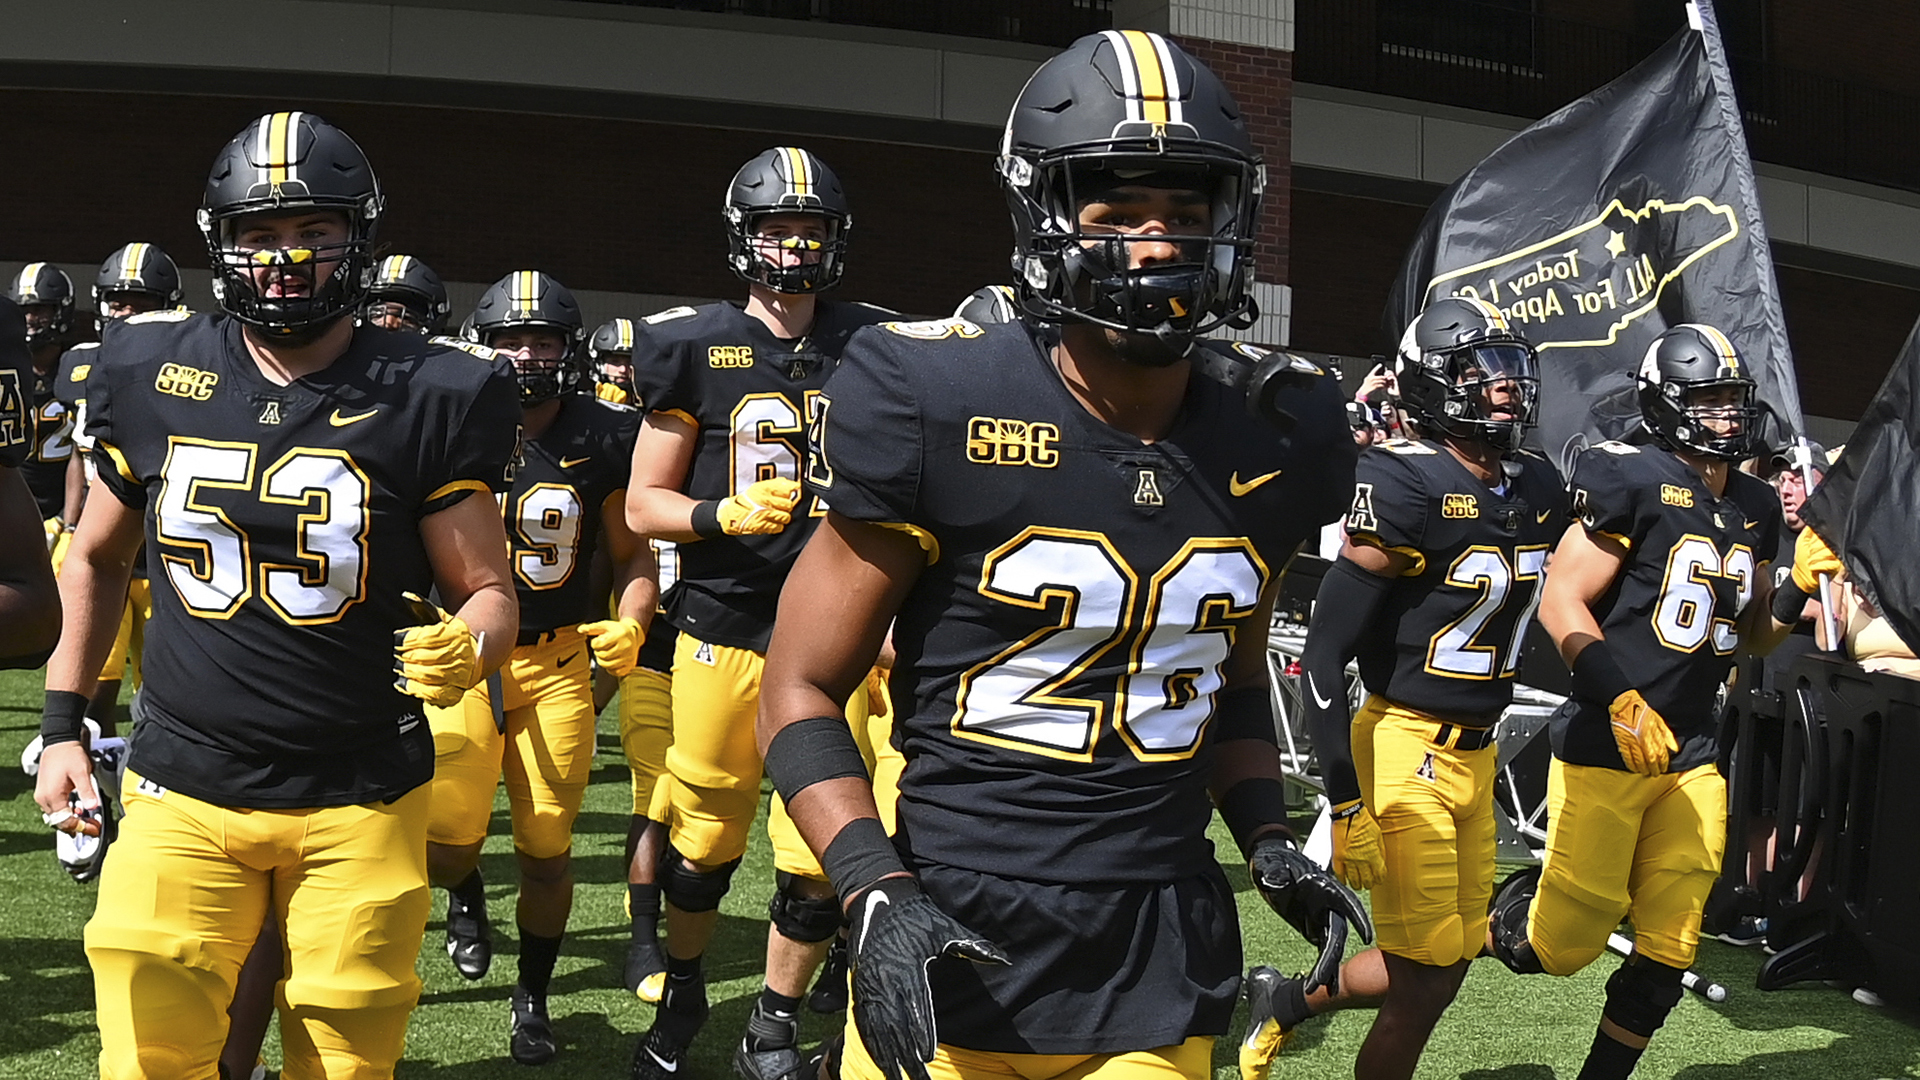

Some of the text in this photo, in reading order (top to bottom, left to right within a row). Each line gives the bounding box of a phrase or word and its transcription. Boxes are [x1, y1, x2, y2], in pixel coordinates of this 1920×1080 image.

[708, 346, 754, 369] SBC
[155, 362, 219, 401] SBC
[259, 401, 281, 425] A
[966, 415, 1061, 469] SBC
[1133, 470, 1164, 506] A
[1346, 482, 1378, 531] A
[1441, 493, 1480, 519] SBC
[1660, 483, 1695, 508] SBC
[156, 435, 371, 626] 53
[497, 481, 584, 591] 9
[1424, 543, 1550, 681] 27
[1651, 533, 1755, 656] 63
[950, 524, 1271, 763] 26
[1414, 750, 1437, 784] A
